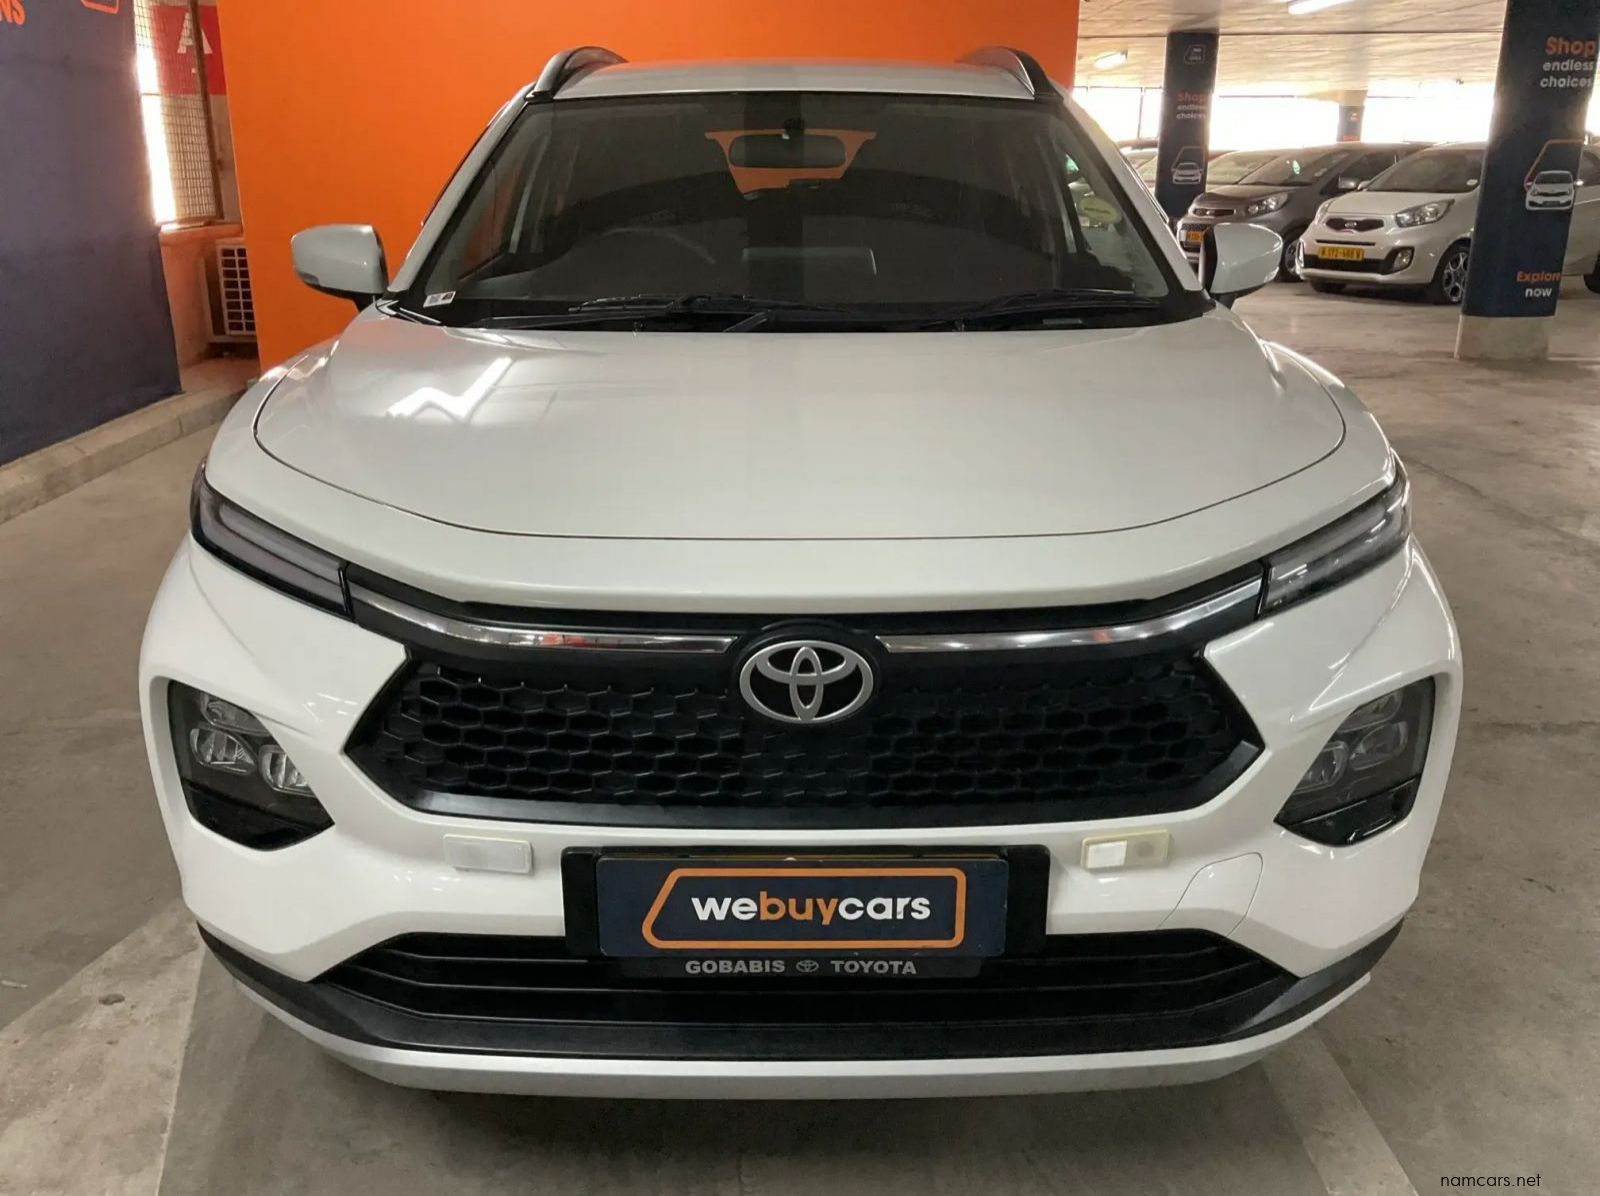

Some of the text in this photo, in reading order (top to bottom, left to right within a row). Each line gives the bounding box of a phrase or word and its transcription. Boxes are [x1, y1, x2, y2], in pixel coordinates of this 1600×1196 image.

[1545, 36, 1597, 57] Shop
[1542, 60, 1594, 72] endless
[1525, 287, 1552, 297] now
[691, 891, 931, 925] webuycars
[685, 960, 917, 975] GOBABIS TOYOTA
